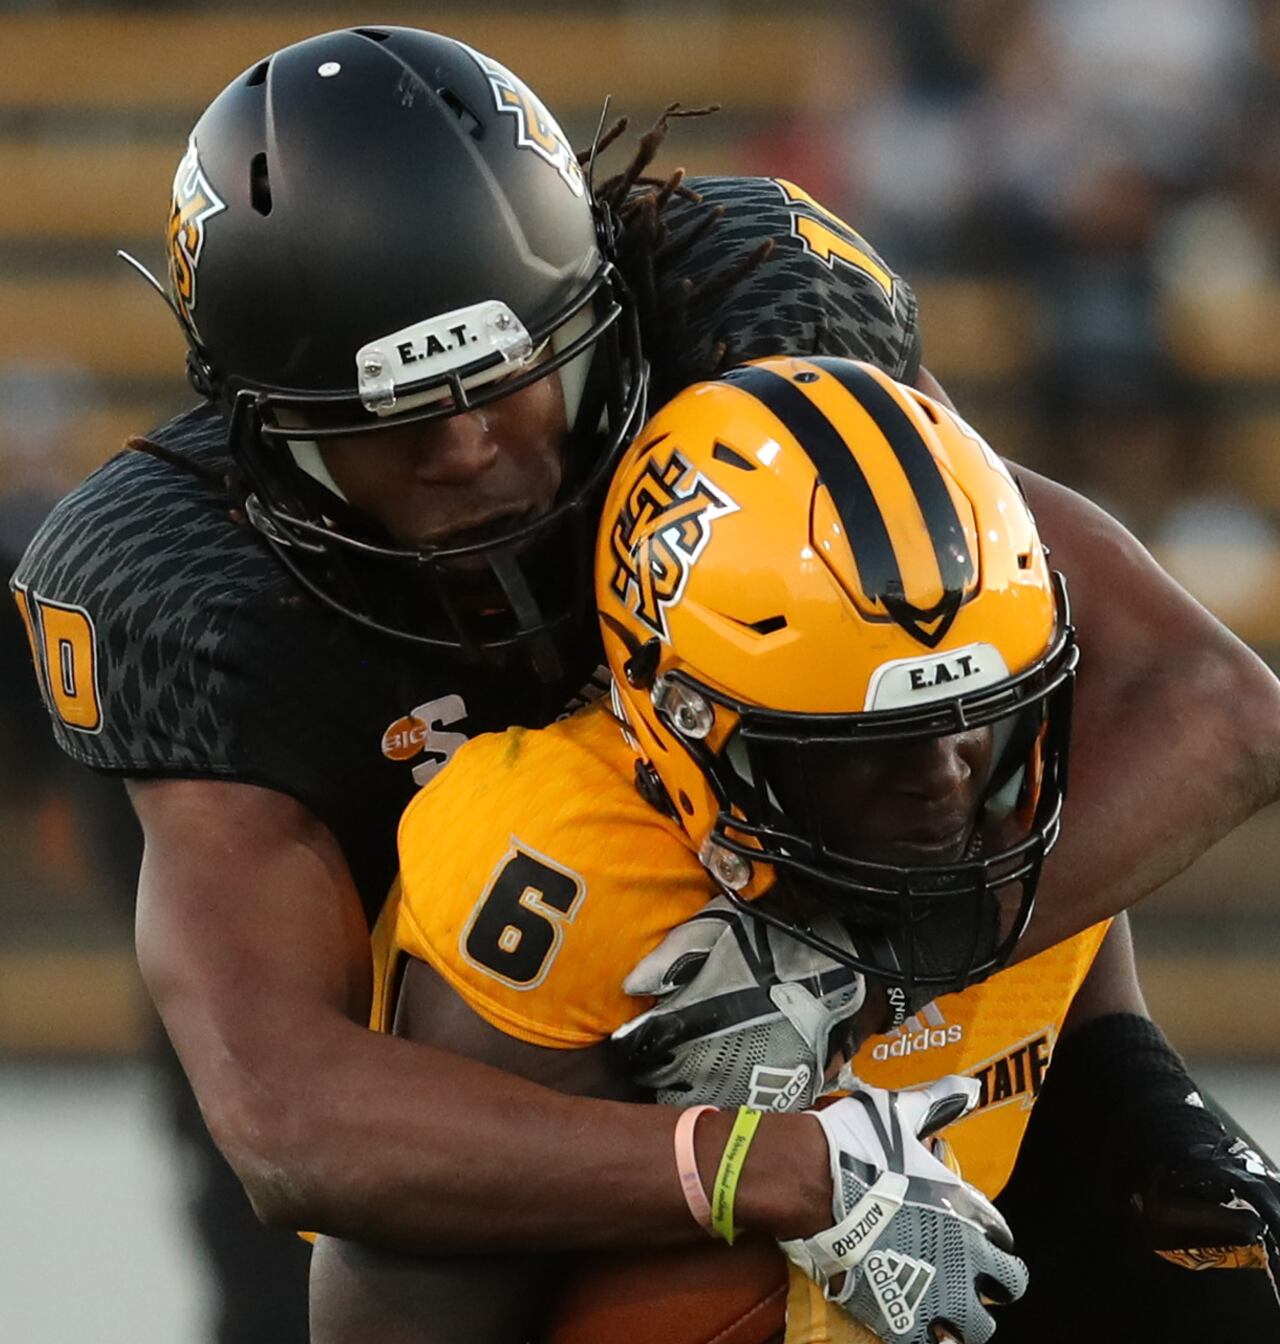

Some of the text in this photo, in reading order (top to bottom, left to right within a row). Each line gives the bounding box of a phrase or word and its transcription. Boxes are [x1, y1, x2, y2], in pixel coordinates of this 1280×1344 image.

[396, 323, 478, 365] E.A.T.
[908, 654, 981, 691] E.A.T.
[384, 729, 428, 751] BIG
[458, 832, 588, 992] 6
[872, 1024, 963, 1062] adidas
[974, 1036, 1057, 1109] TATE
[867, 1256, 910, 1331] adidas
